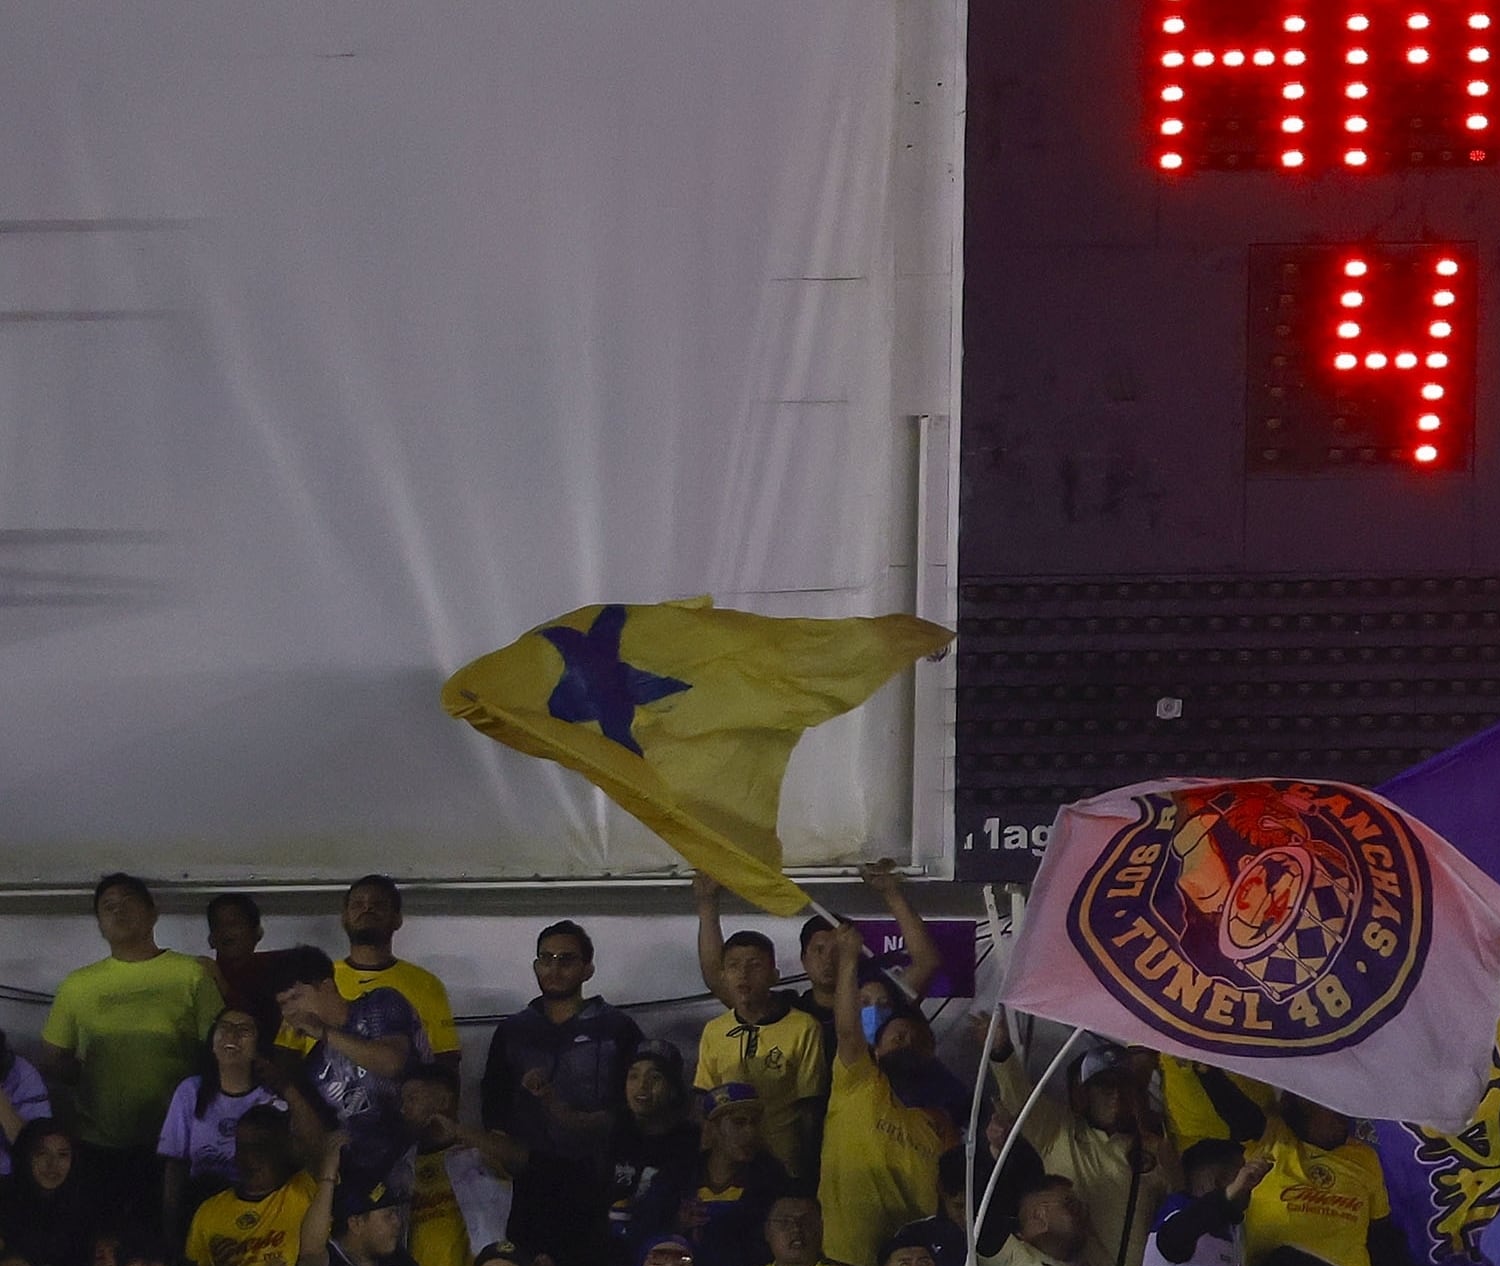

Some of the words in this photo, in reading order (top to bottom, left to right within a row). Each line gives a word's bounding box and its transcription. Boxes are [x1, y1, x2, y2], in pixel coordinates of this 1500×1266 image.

[1330, 255, 1461, 465] 4
[1106, 842, 1161, 899] LOS
[1111, 916, 1275, 1032] TUNEL
[1289, 980, 1353, 1028] 48
